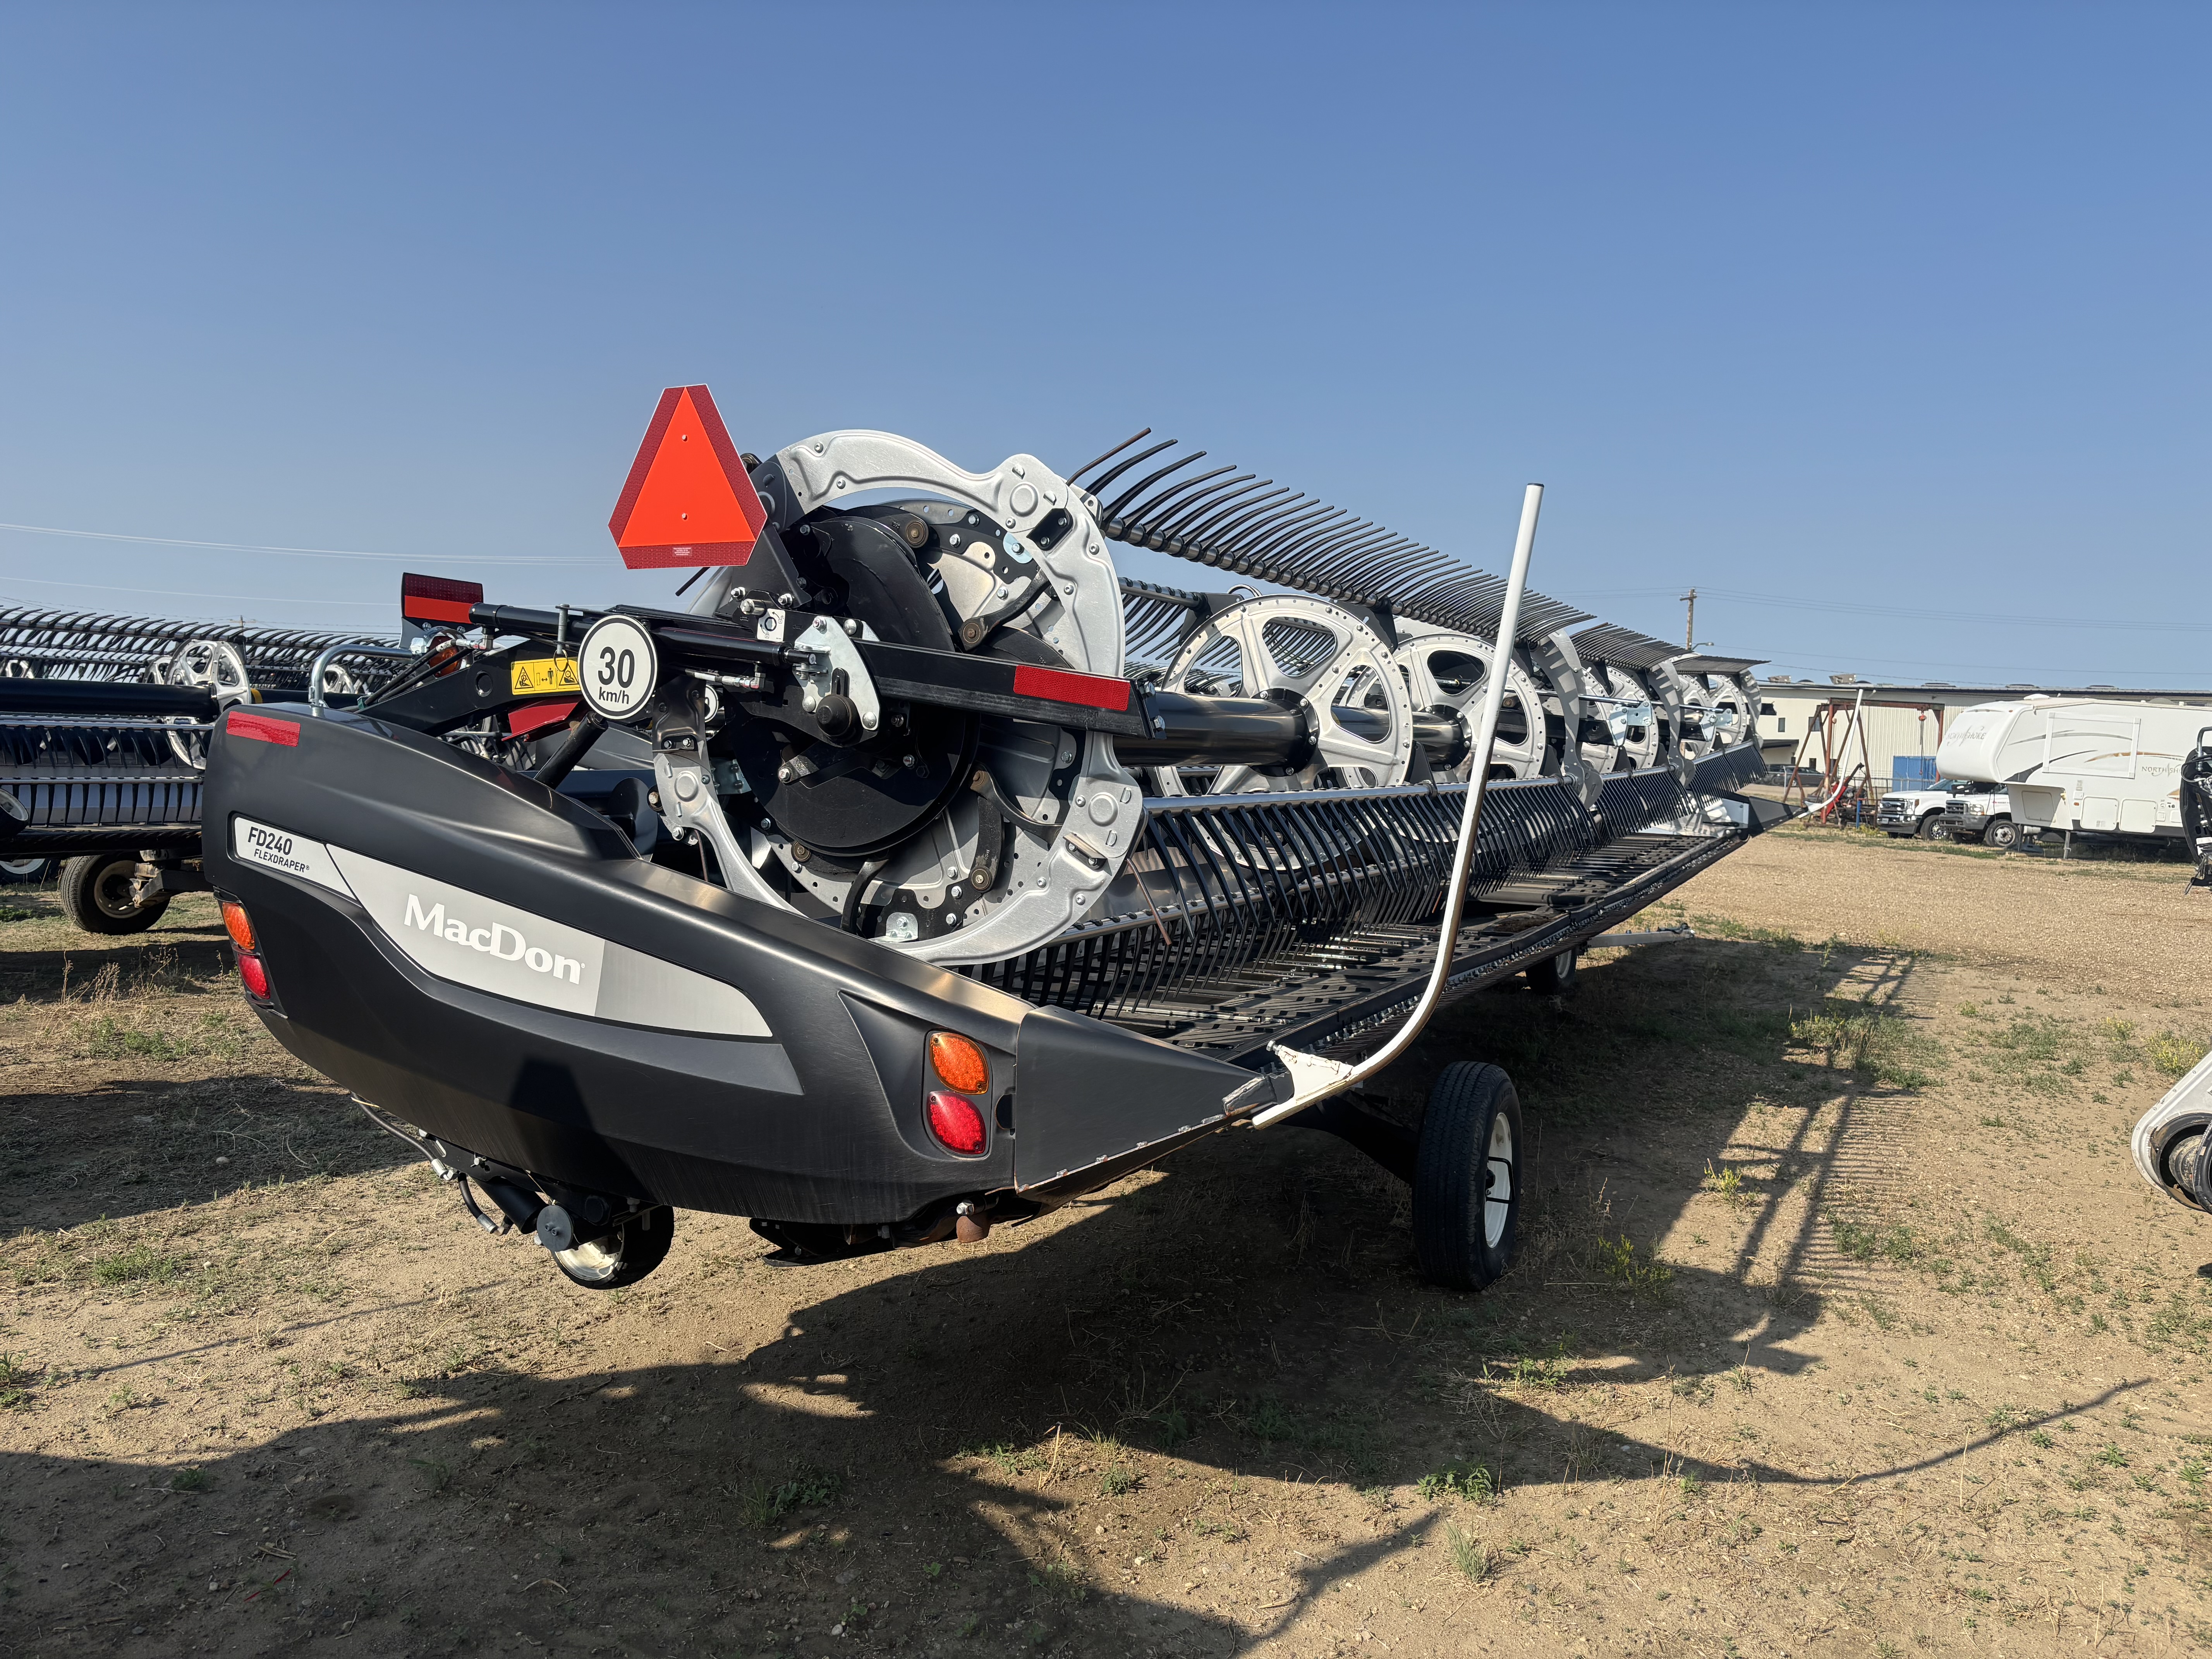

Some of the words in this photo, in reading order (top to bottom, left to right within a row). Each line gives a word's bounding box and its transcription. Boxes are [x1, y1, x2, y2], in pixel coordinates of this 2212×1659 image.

[598, 646, 635, 688] 30
[599, 687, 629, 704] km/h
[248, 826, 292, 855] FD240
[404, 893, 581, 985] MacDon
